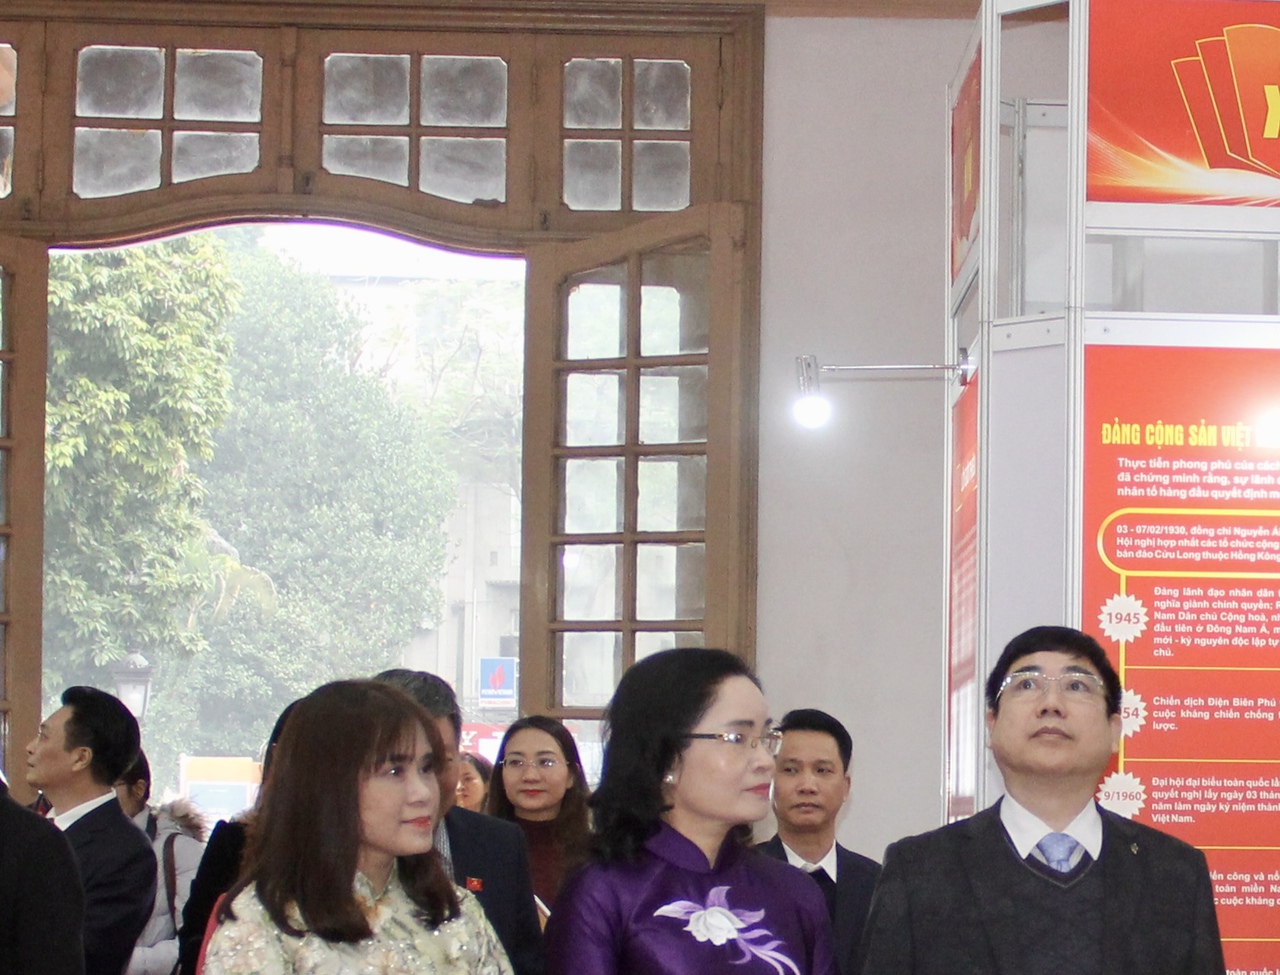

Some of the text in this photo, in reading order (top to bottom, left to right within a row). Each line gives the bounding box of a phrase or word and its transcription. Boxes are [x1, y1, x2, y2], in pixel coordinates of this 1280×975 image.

[1102, 417, 1140, 445] ĐẢNG
[1146, 420, 1184, 449] CỘNG
[1189, 419, 1217, 446] SẢN
[1222, 421, 1250, 451] VIỆT
[1107, 612, 1140, 624] 1945
[1153, 694, 1180, 706] Chiến
[1184, 696, 1204, 709] dịch
[1208, 697, 1230, 709] Điện
[1233, 697, 1254, 707] Biên
[1258, 697, 1276, 707] Phủ
[1122, 707, 1139, 719] 54
[1153, 708, 1176, 721] cuộc
[1181, 708, 1210, 721] kháng
[1214, 707, 1240, 719] chiến
[1244, 708, 1274, 722] chống
[1104, 791, 1142, 802] 9/1960
[1152, 813, 1195, 826] Việt Nam.
